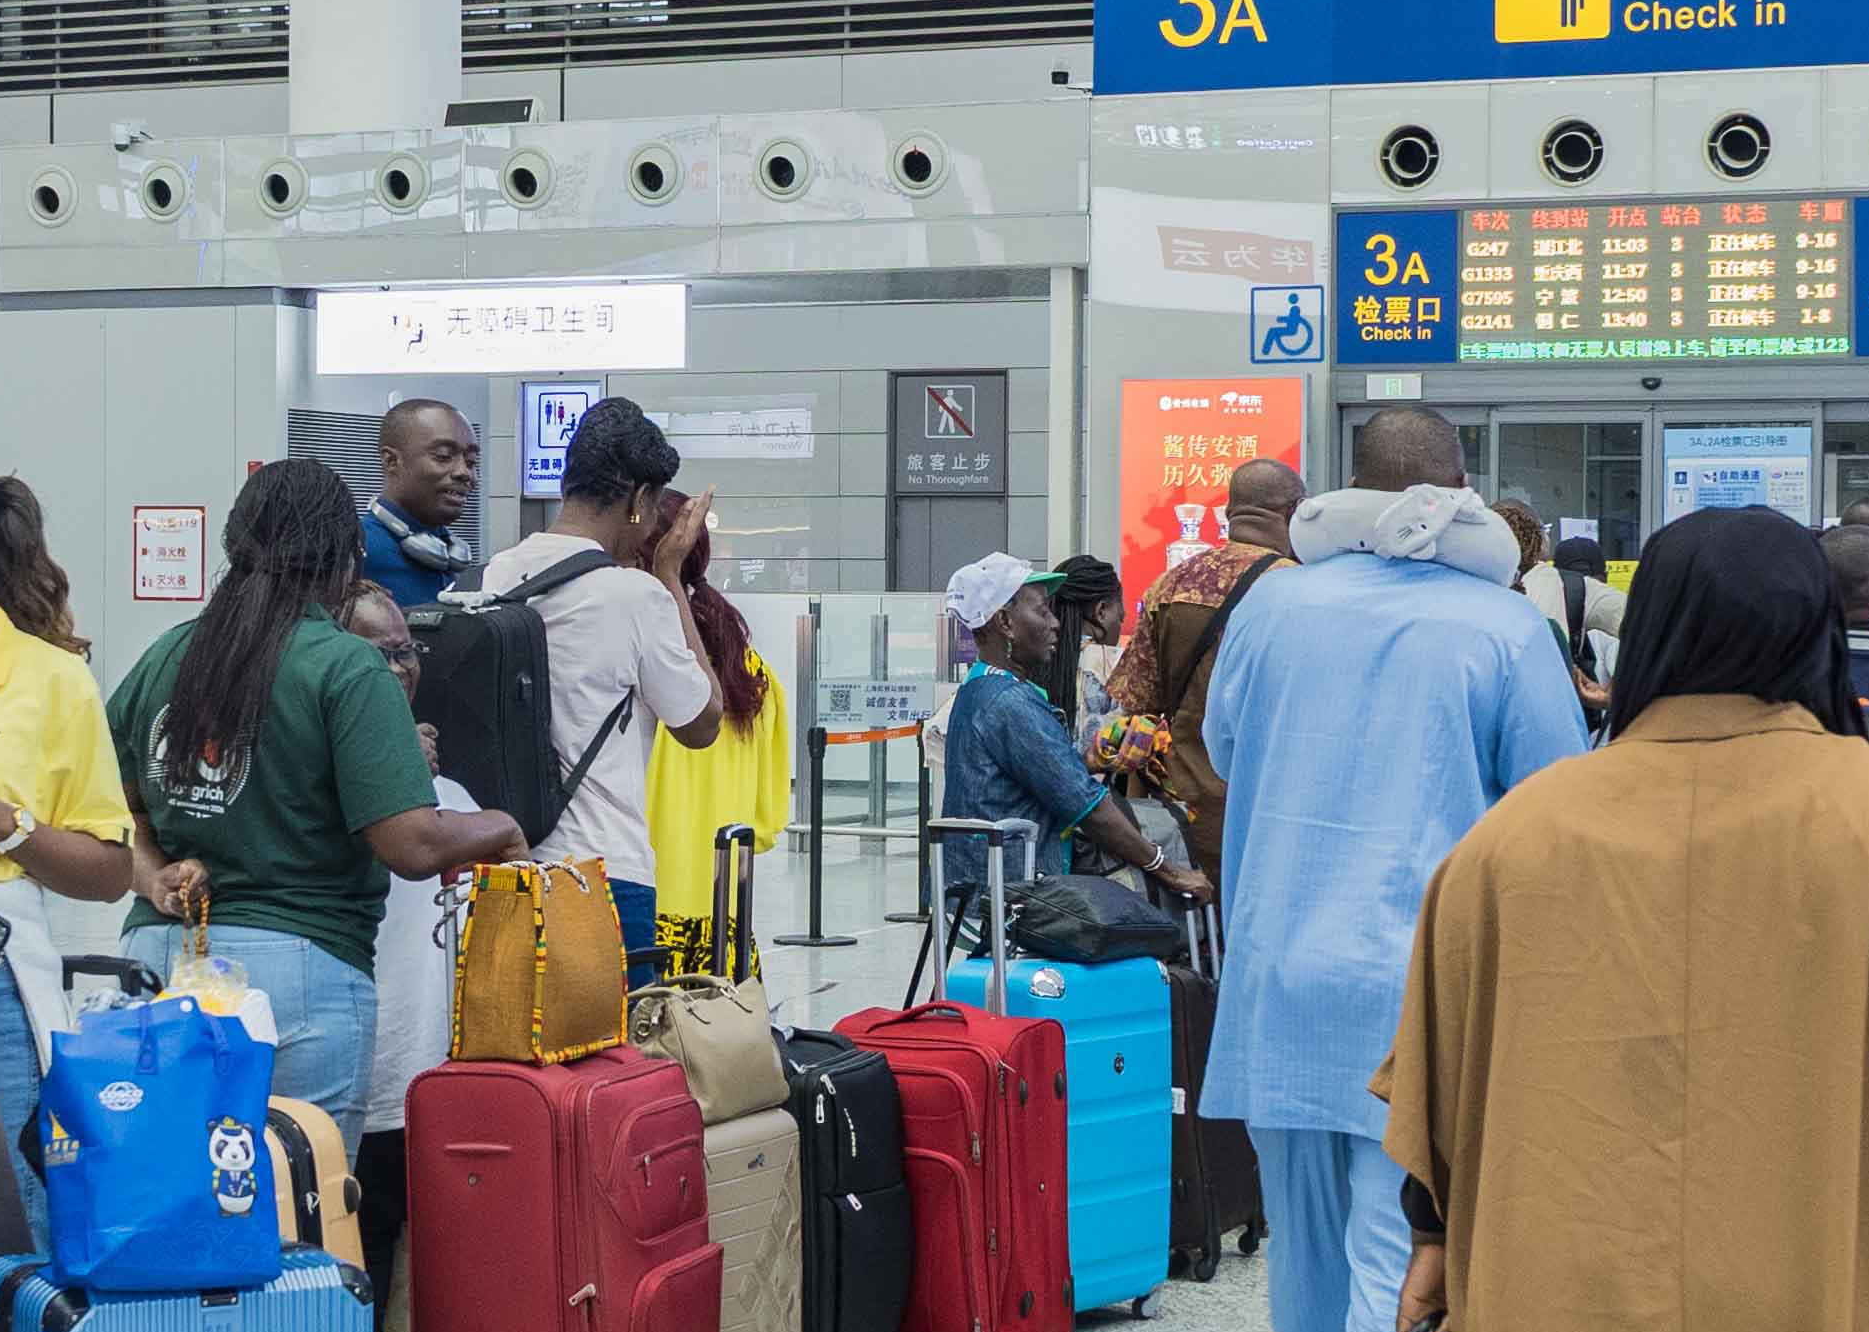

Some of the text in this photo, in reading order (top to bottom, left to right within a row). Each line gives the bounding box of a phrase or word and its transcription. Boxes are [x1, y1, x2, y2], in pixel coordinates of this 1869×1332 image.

[1473, 212, 1509, 231] 车次
[1532, 209, 1588, 229] 终到站
[1608, 208, 1647, 226] 开点
[1661, 206, 1700, 225] 站台
[1722, 204, 1766, 224] 状态
[1467, 241, 1509, 257] G247
[1364, 233, 1430, 286] 3A
[447, 304, 614, 335] 无障碍卫生间
[1354, 295, 1440, 325] 检票口
[1361, 325, 1431, 343] Check in
[528, 457, 563, 471] 无障碍
[907, 452, 991, 472] 旅客止步
[908, 473, 989, 486] No Thoroughfare
